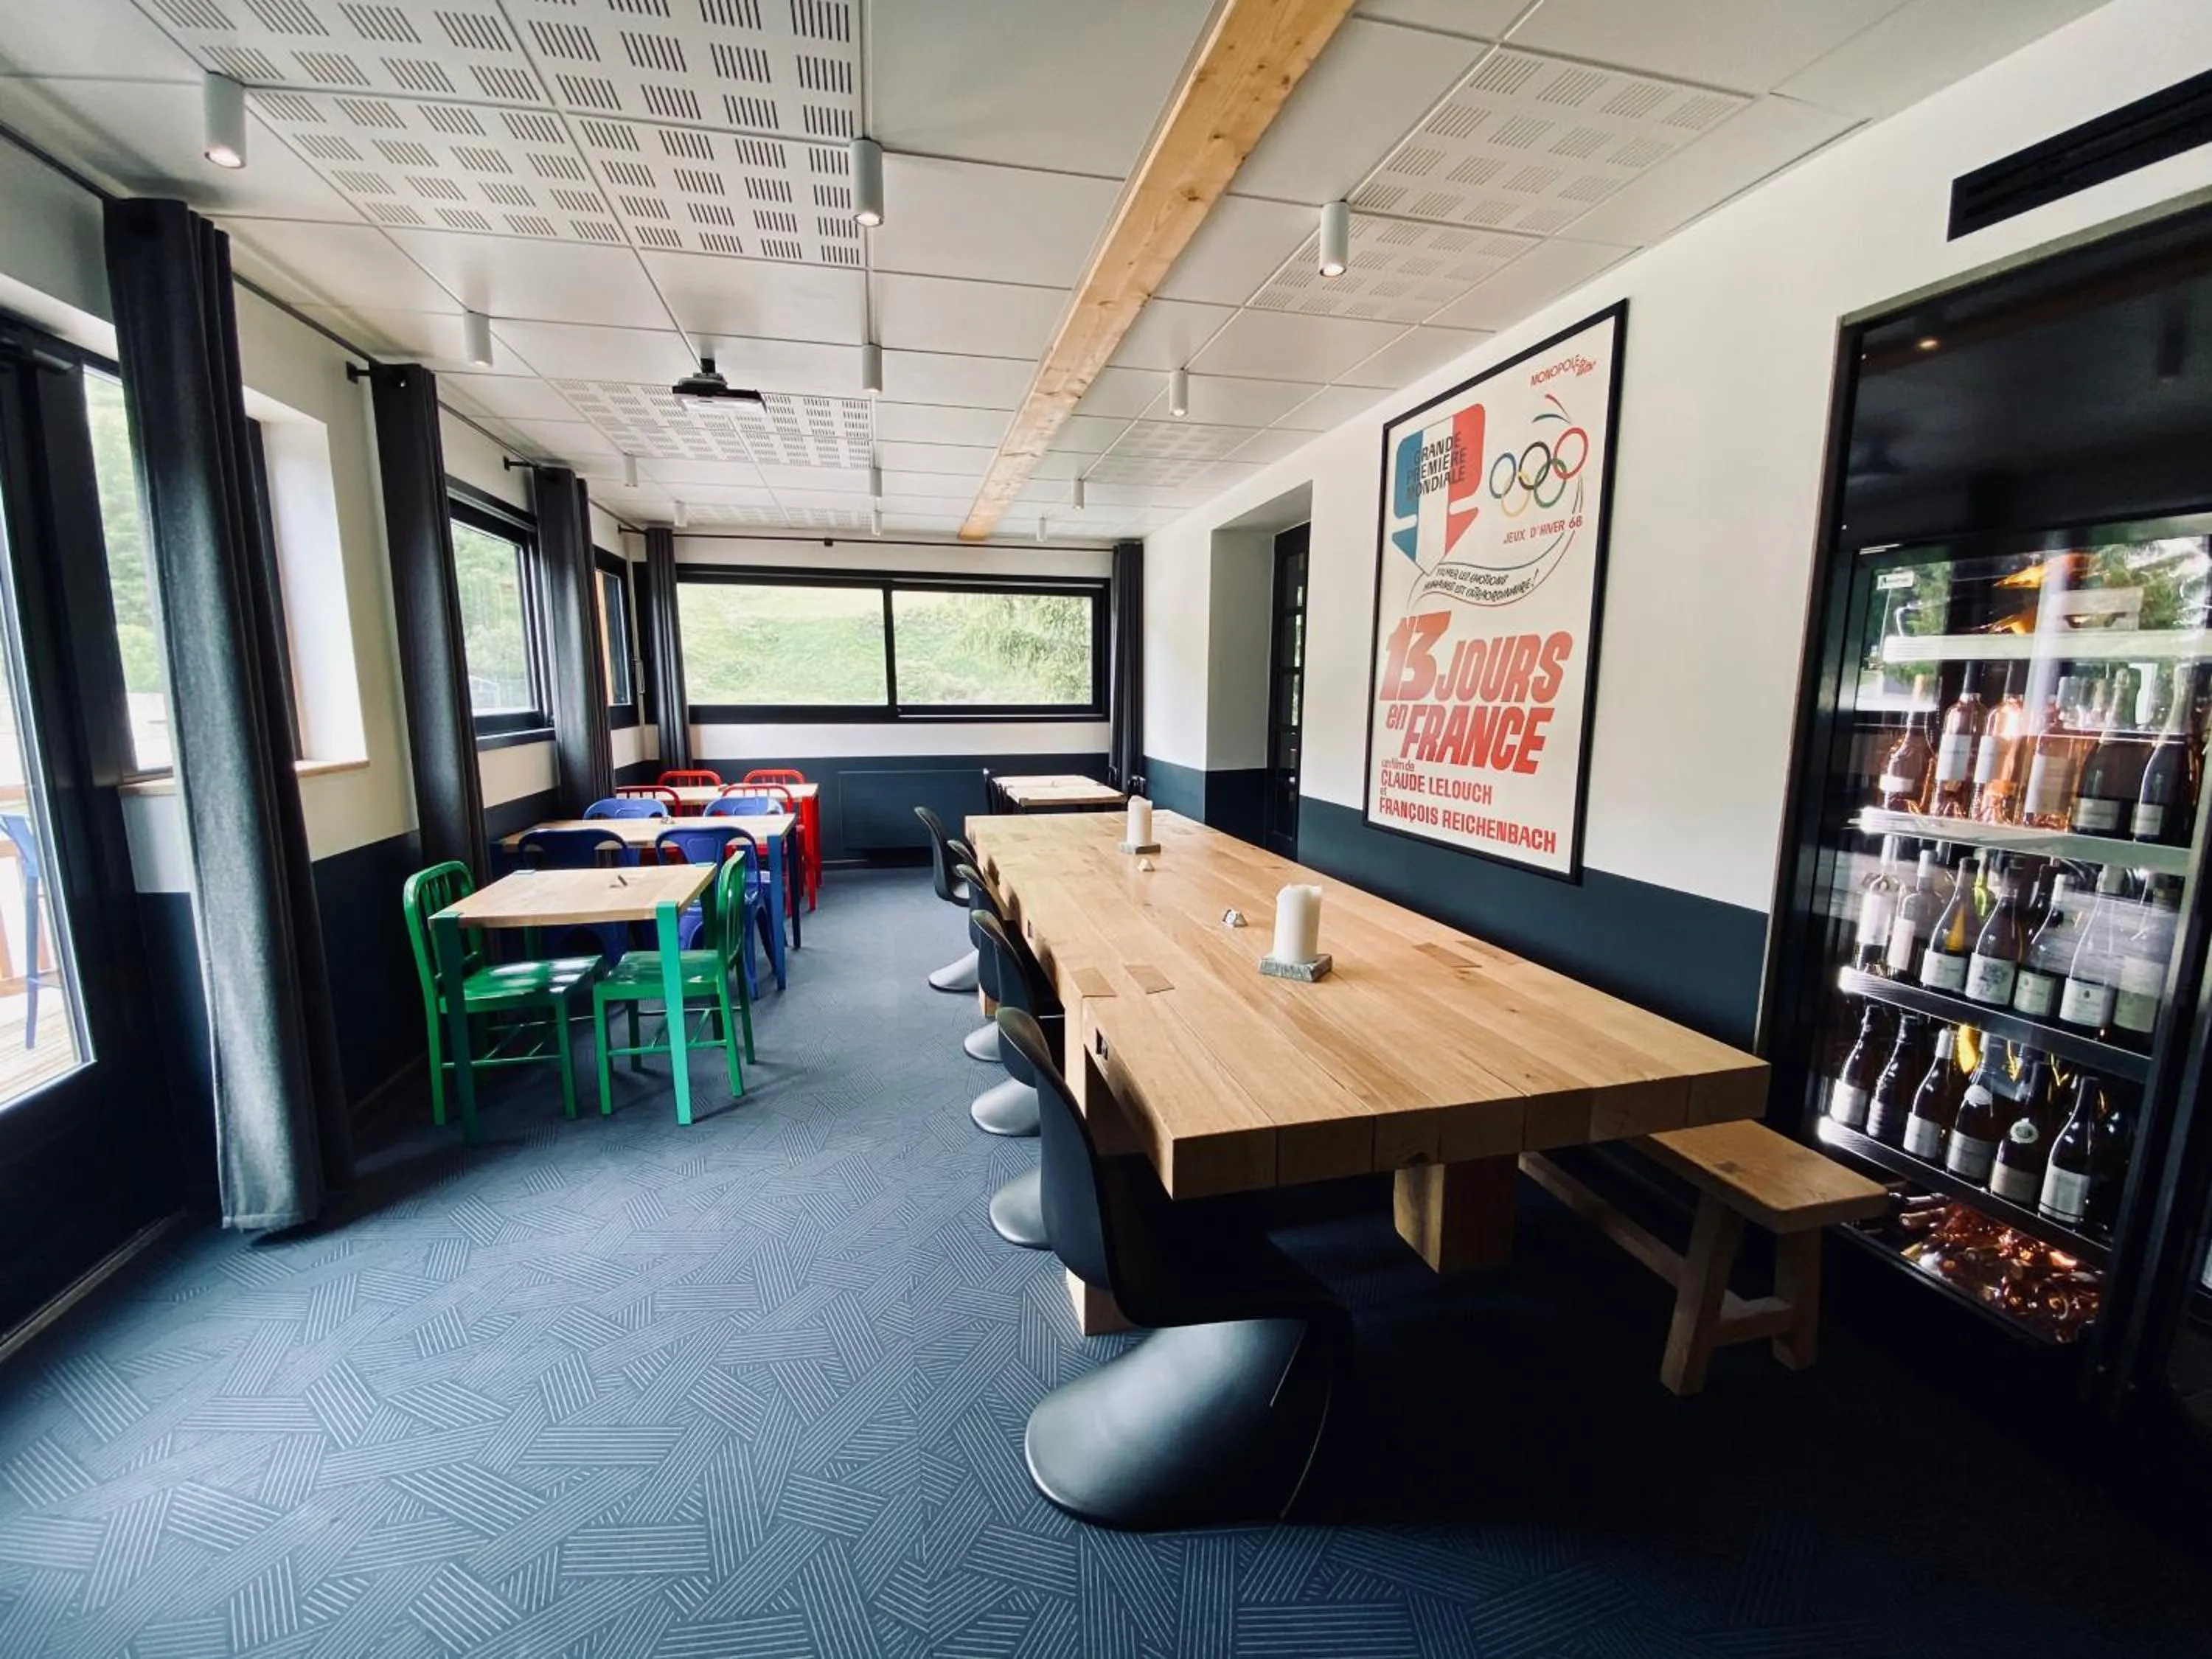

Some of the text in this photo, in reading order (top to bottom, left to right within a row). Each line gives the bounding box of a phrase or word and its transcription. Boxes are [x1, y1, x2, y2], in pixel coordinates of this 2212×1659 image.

[1414, 431, 1461, 465] GRANDE
[1405, 465, 1466, 500] MONDIALE
[1503, 515, 1582, 544] JEUX D'HIVER 68
[1380, 611, 1573, 703] 13 JOURS
[1385, 703, 1555, 775] en FRANCE
[1405, 760, 1415, 772] de
[1380, 787, 1388, 796] et
[1381, 769, 1493, 806] CLAUDE LELOUCH
[1380, 797, 1557, 854] FRANÇOIS REICHENBACH
